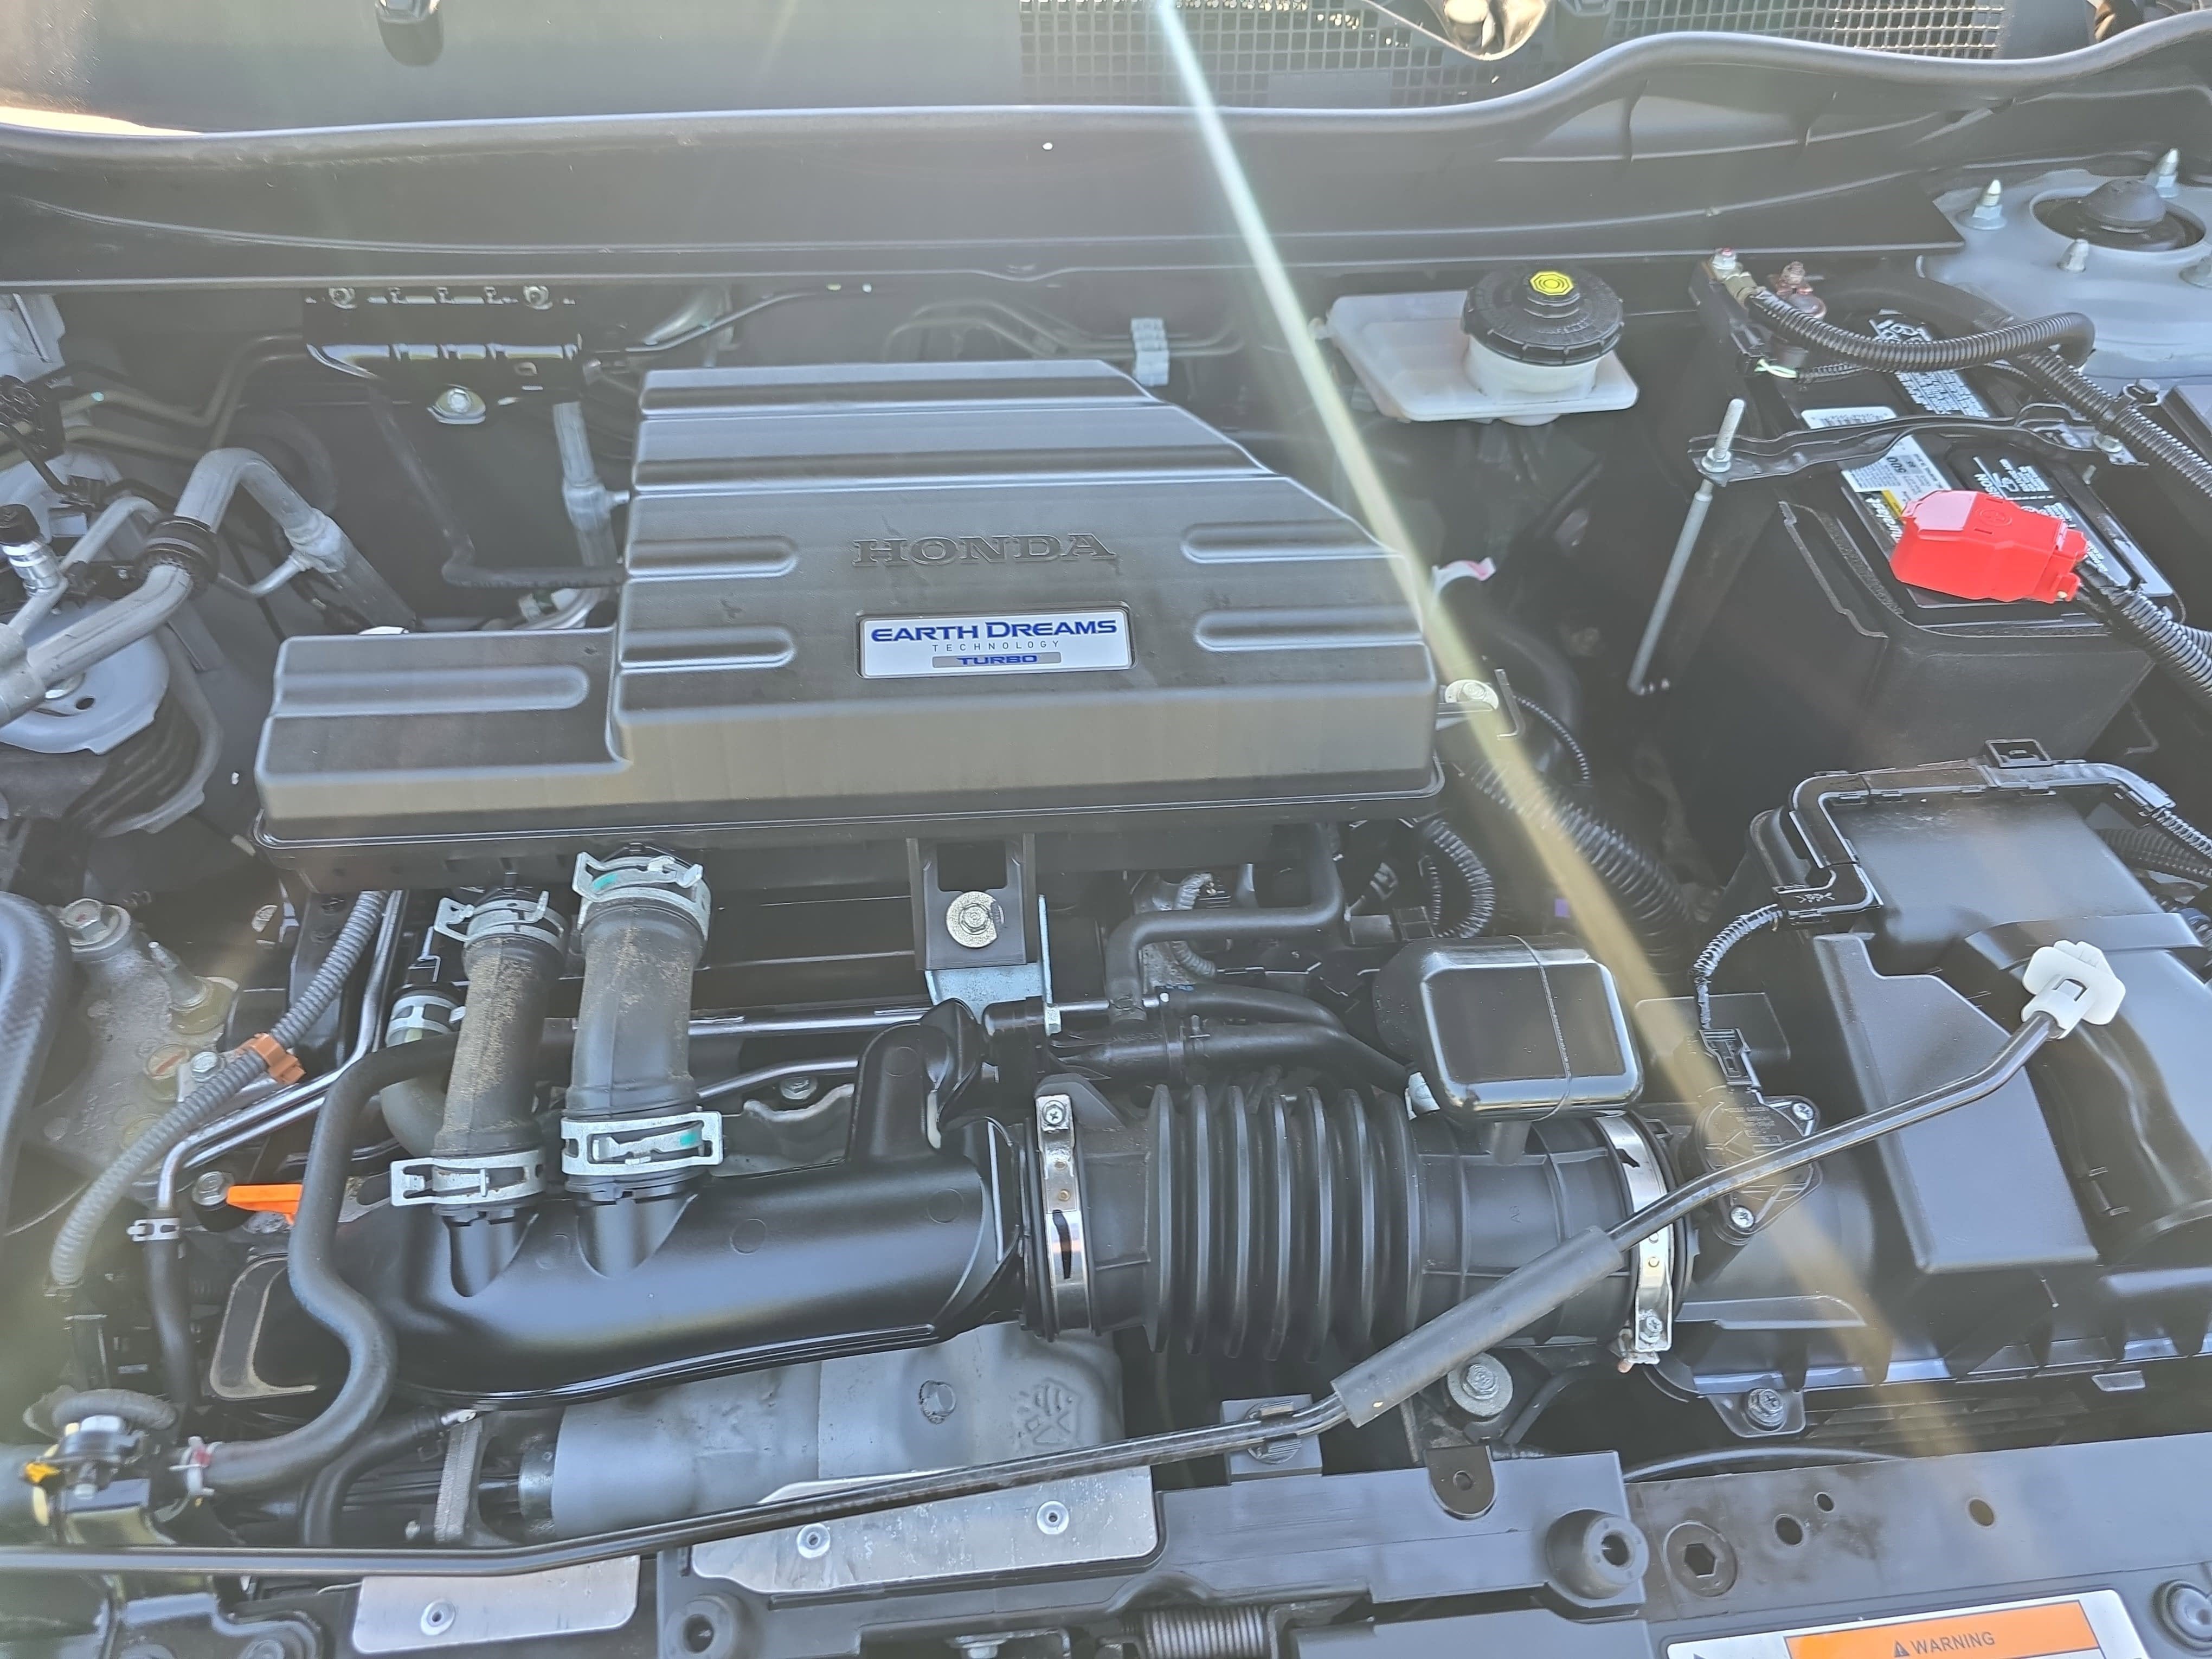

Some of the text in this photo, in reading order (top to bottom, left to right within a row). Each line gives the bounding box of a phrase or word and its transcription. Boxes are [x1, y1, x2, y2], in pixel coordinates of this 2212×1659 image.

[1887, 457, 1907, 473] 500
[852, 533, 1118, 568] HONDA
[871, 620, 1118, 642] EARTH DREAMS
[932, 640, 1059, 652] TECHNOLOGY
[956, 654, 1038, 666] TURBO
[1910, 1631, 1995, 1654] WARNING
